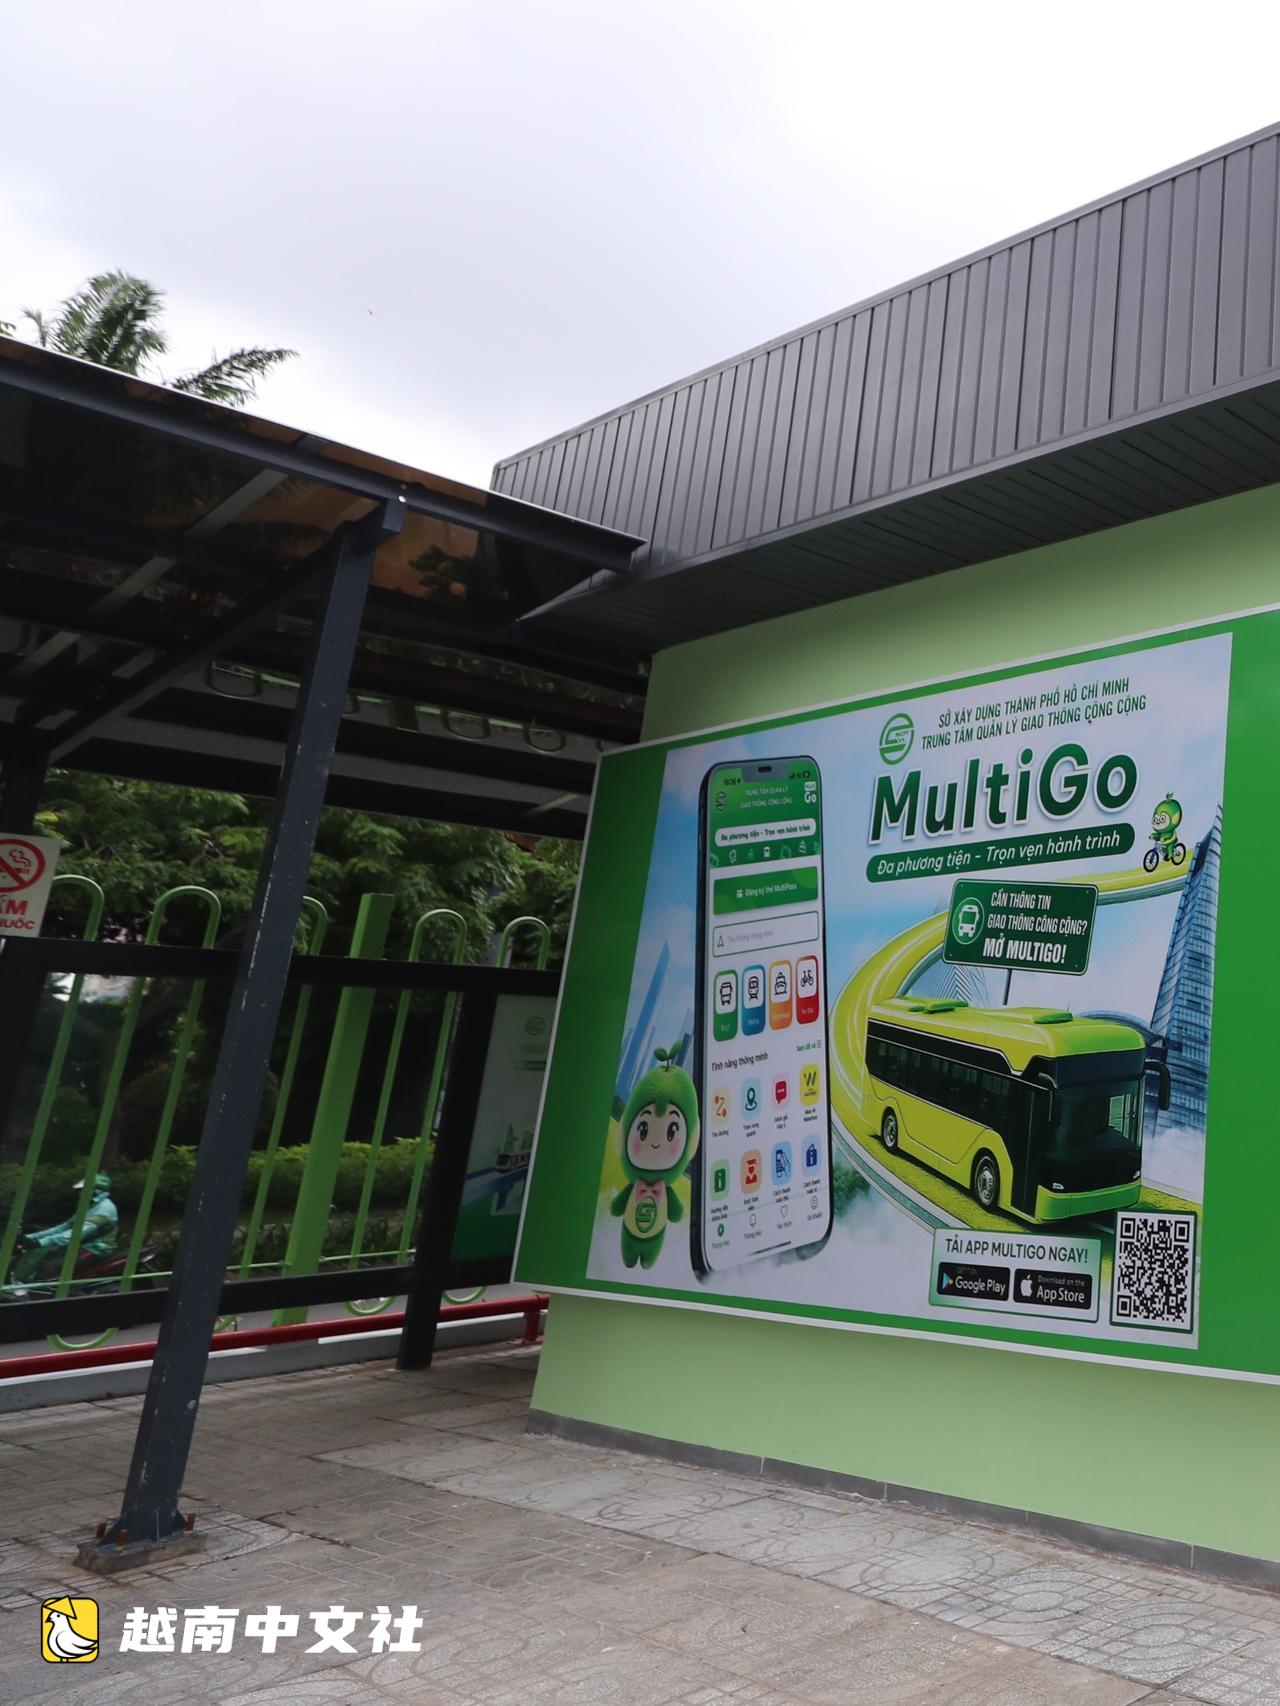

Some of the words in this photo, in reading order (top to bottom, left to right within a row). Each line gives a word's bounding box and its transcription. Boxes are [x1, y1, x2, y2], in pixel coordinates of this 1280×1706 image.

[938, 708, 951, 728] SỞ
[953, 707, 972, 725] XÂY
[975, 703, 1001, 722] DỰNG
[1005, 696, 1036, 715] THÀNH
[1040, 685, 1060, 708] PHỐ
[1063, 682, 1077, 704] HỒ
[1081, 680, 1099, 700] CHÍ
[1102, 677, 1129, 697] MINH
[922, 732, 951, 750] TRUNG
[954, 726, 973, 744] TÂM
[976, 719, 1003, 740] QUẢN
[1005, 716, 1018, 734] LÝ
[1021, 713, 1044, 732] GIAO
[1048, 707, 1081, 726] THÔNG
[1084, 701, 1113, 720] CÔNG
[1117, 695, 1147, 716] CỘNG
[869, 743, 1138, 844] MultiGo
[877, 859, 894, 875] Đa
[895, 855, 943, 876] phương
[946, 849, 971, 870] tiện
[986, 846, 1015, 865] Trọn
[1019, 847, 1043, 861] vẹn
[1046, 836, 1081, 855] hành
[1085, 830, 1120, 850] trình
[991, 888, 1007, 906] CẦN
[1009, 891, 1036, 909] THÔNG
[1037, 894, 1051, 910] TIN
[987, 913, 1006, 929] GIAO
[1007, 913, 1034, 931] THÔNG
[1035, 916, 1058, 933] CÔNG
[1059, 916, 1087, 937] CỘNG?
[982, 932, 1004, 958] MỞ
[1005, 938, 1067, 964] MULTIGO!
[945, 1234, 963, 1254] TẢI
[964, 1241, 989, 1255] APP
[991, 1242, 1046, 1259] MULTIGO
[1048, 1246, 1088, 1263] NGAY!
[955, 1276, 985, 1294] Google
[987, 1279, 1006, 1296] Play
[1036, 1286, 1057, 1303] App
[1058, 1288, 1085, 1303] Store
